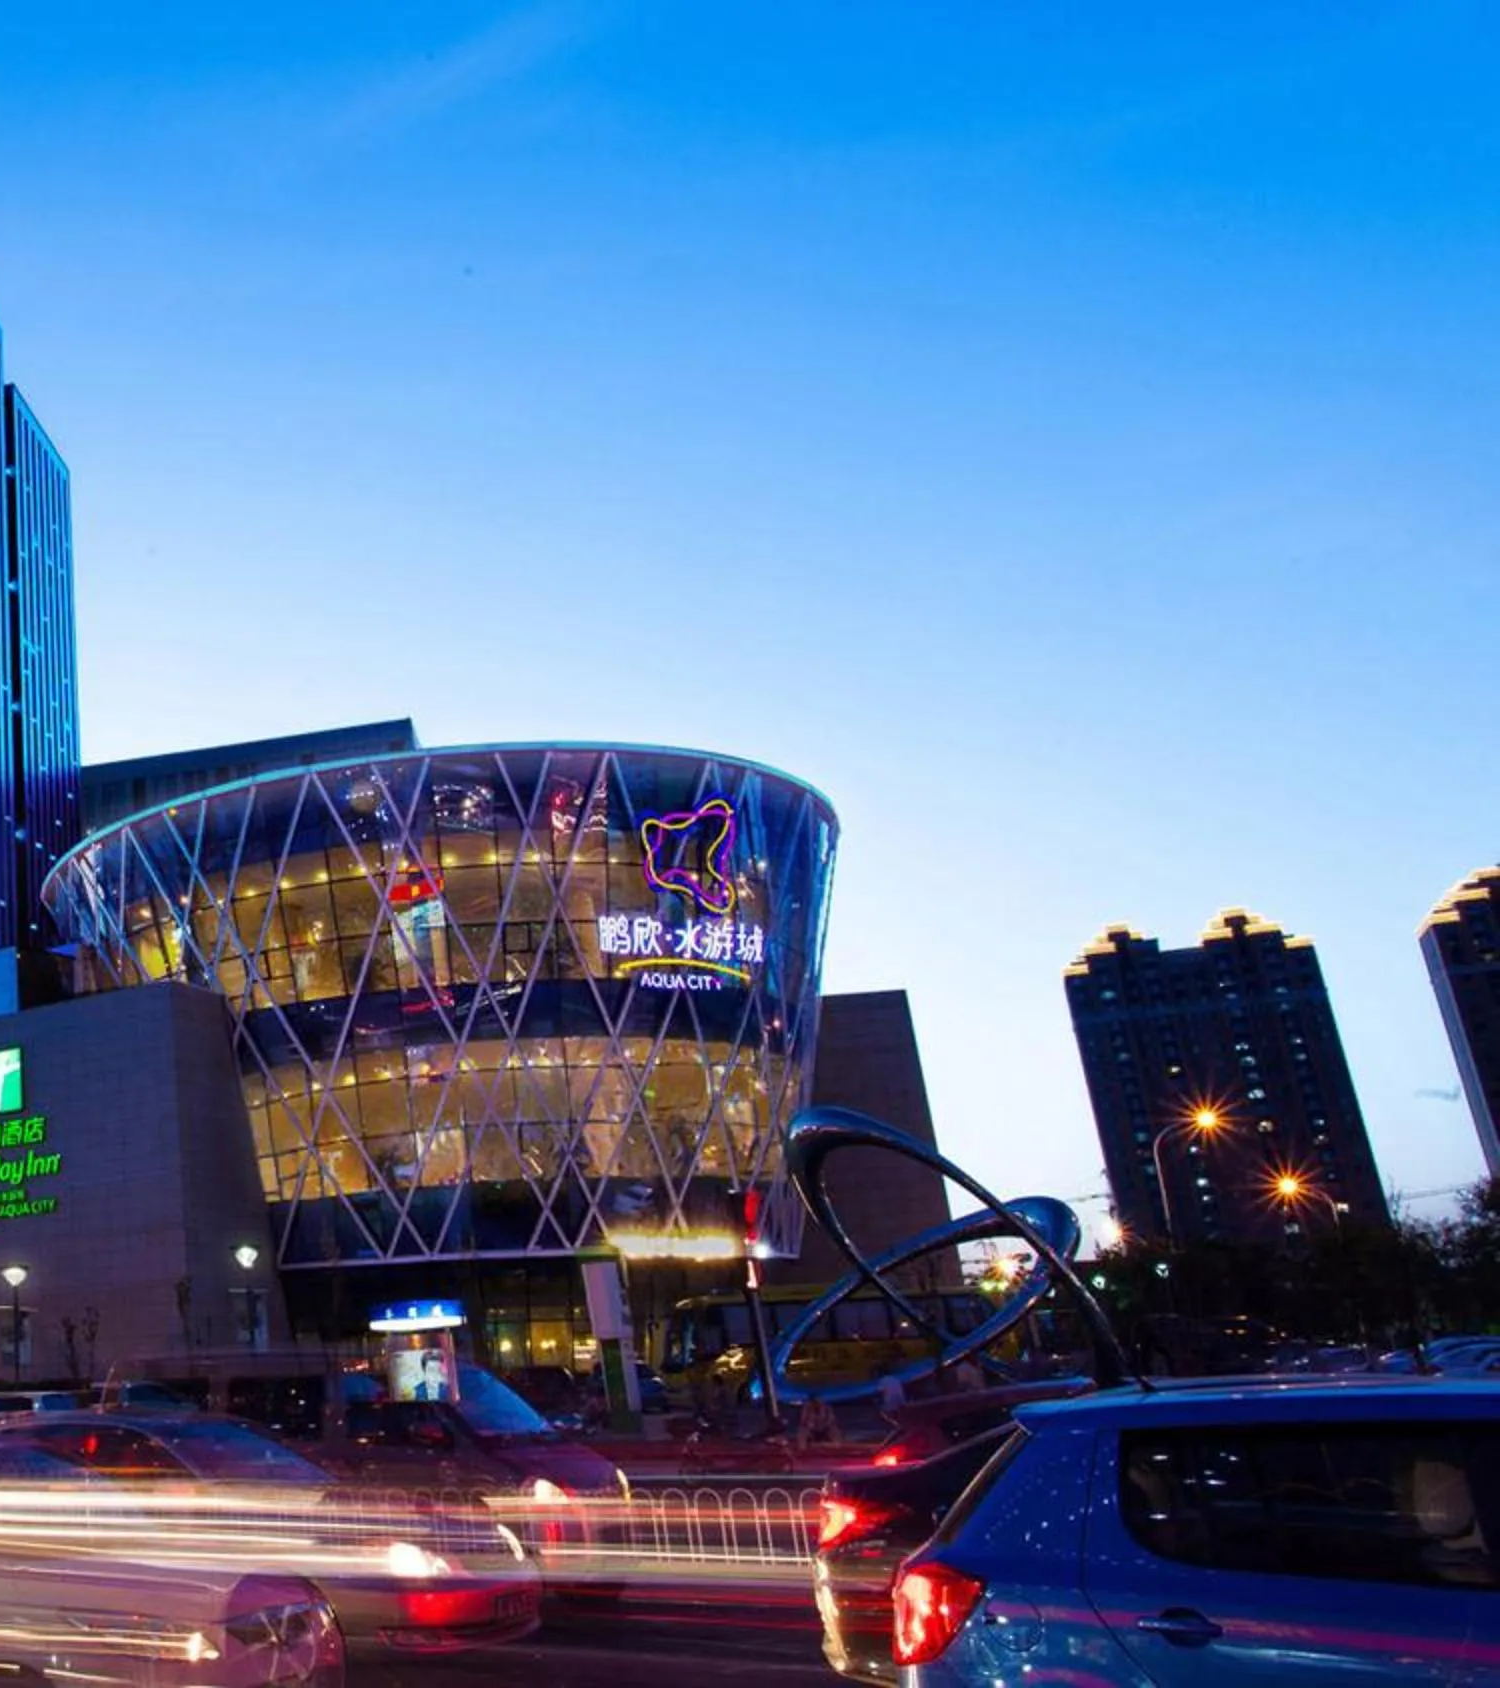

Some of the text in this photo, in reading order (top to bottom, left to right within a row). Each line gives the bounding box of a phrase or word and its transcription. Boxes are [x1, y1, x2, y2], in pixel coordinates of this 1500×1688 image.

[640, 972, 722, 991] AQUA CITY
[26, 1150, 61, 1178] Inn
[31, 1198, 56, 1214] CITY
